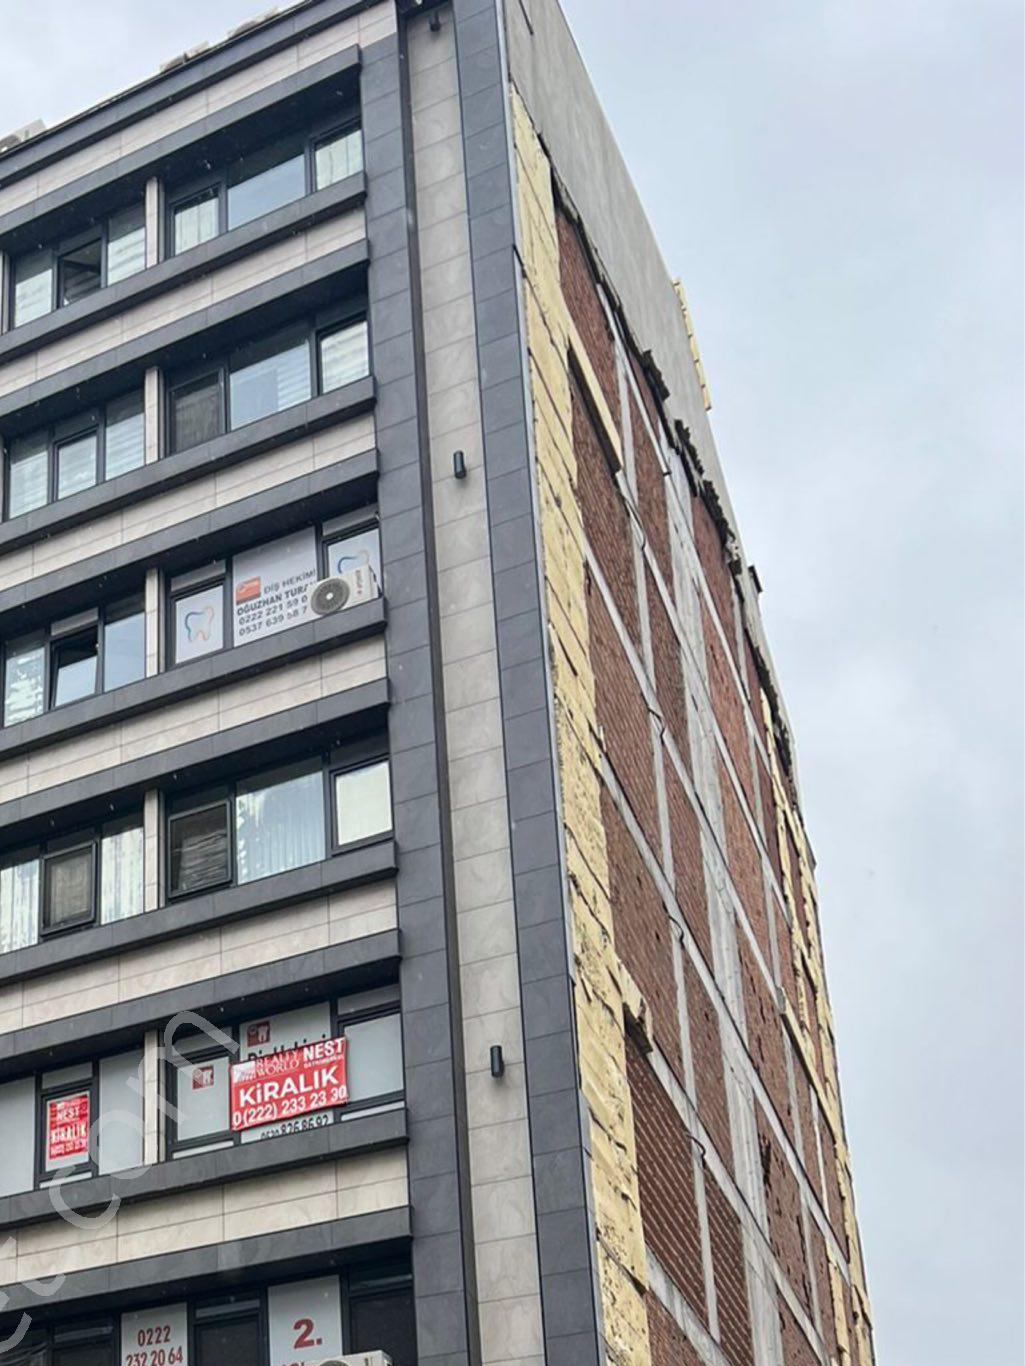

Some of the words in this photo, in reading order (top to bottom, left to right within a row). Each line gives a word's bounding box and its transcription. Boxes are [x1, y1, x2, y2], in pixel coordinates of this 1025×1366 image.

[304, 1039, 345, 1061] NEST
[239, 1065, 339, 1107] KİRALIK
[282, 1096, 306, 1115] 233
[311, 1091, 327, 1109] 23
[331, 1085, 347, 1102] 30
[137, 1325, 171, 1347] 0222
[293, 1318, 323, 1349] 2.
[168, 1346, 184, 1366] 64
